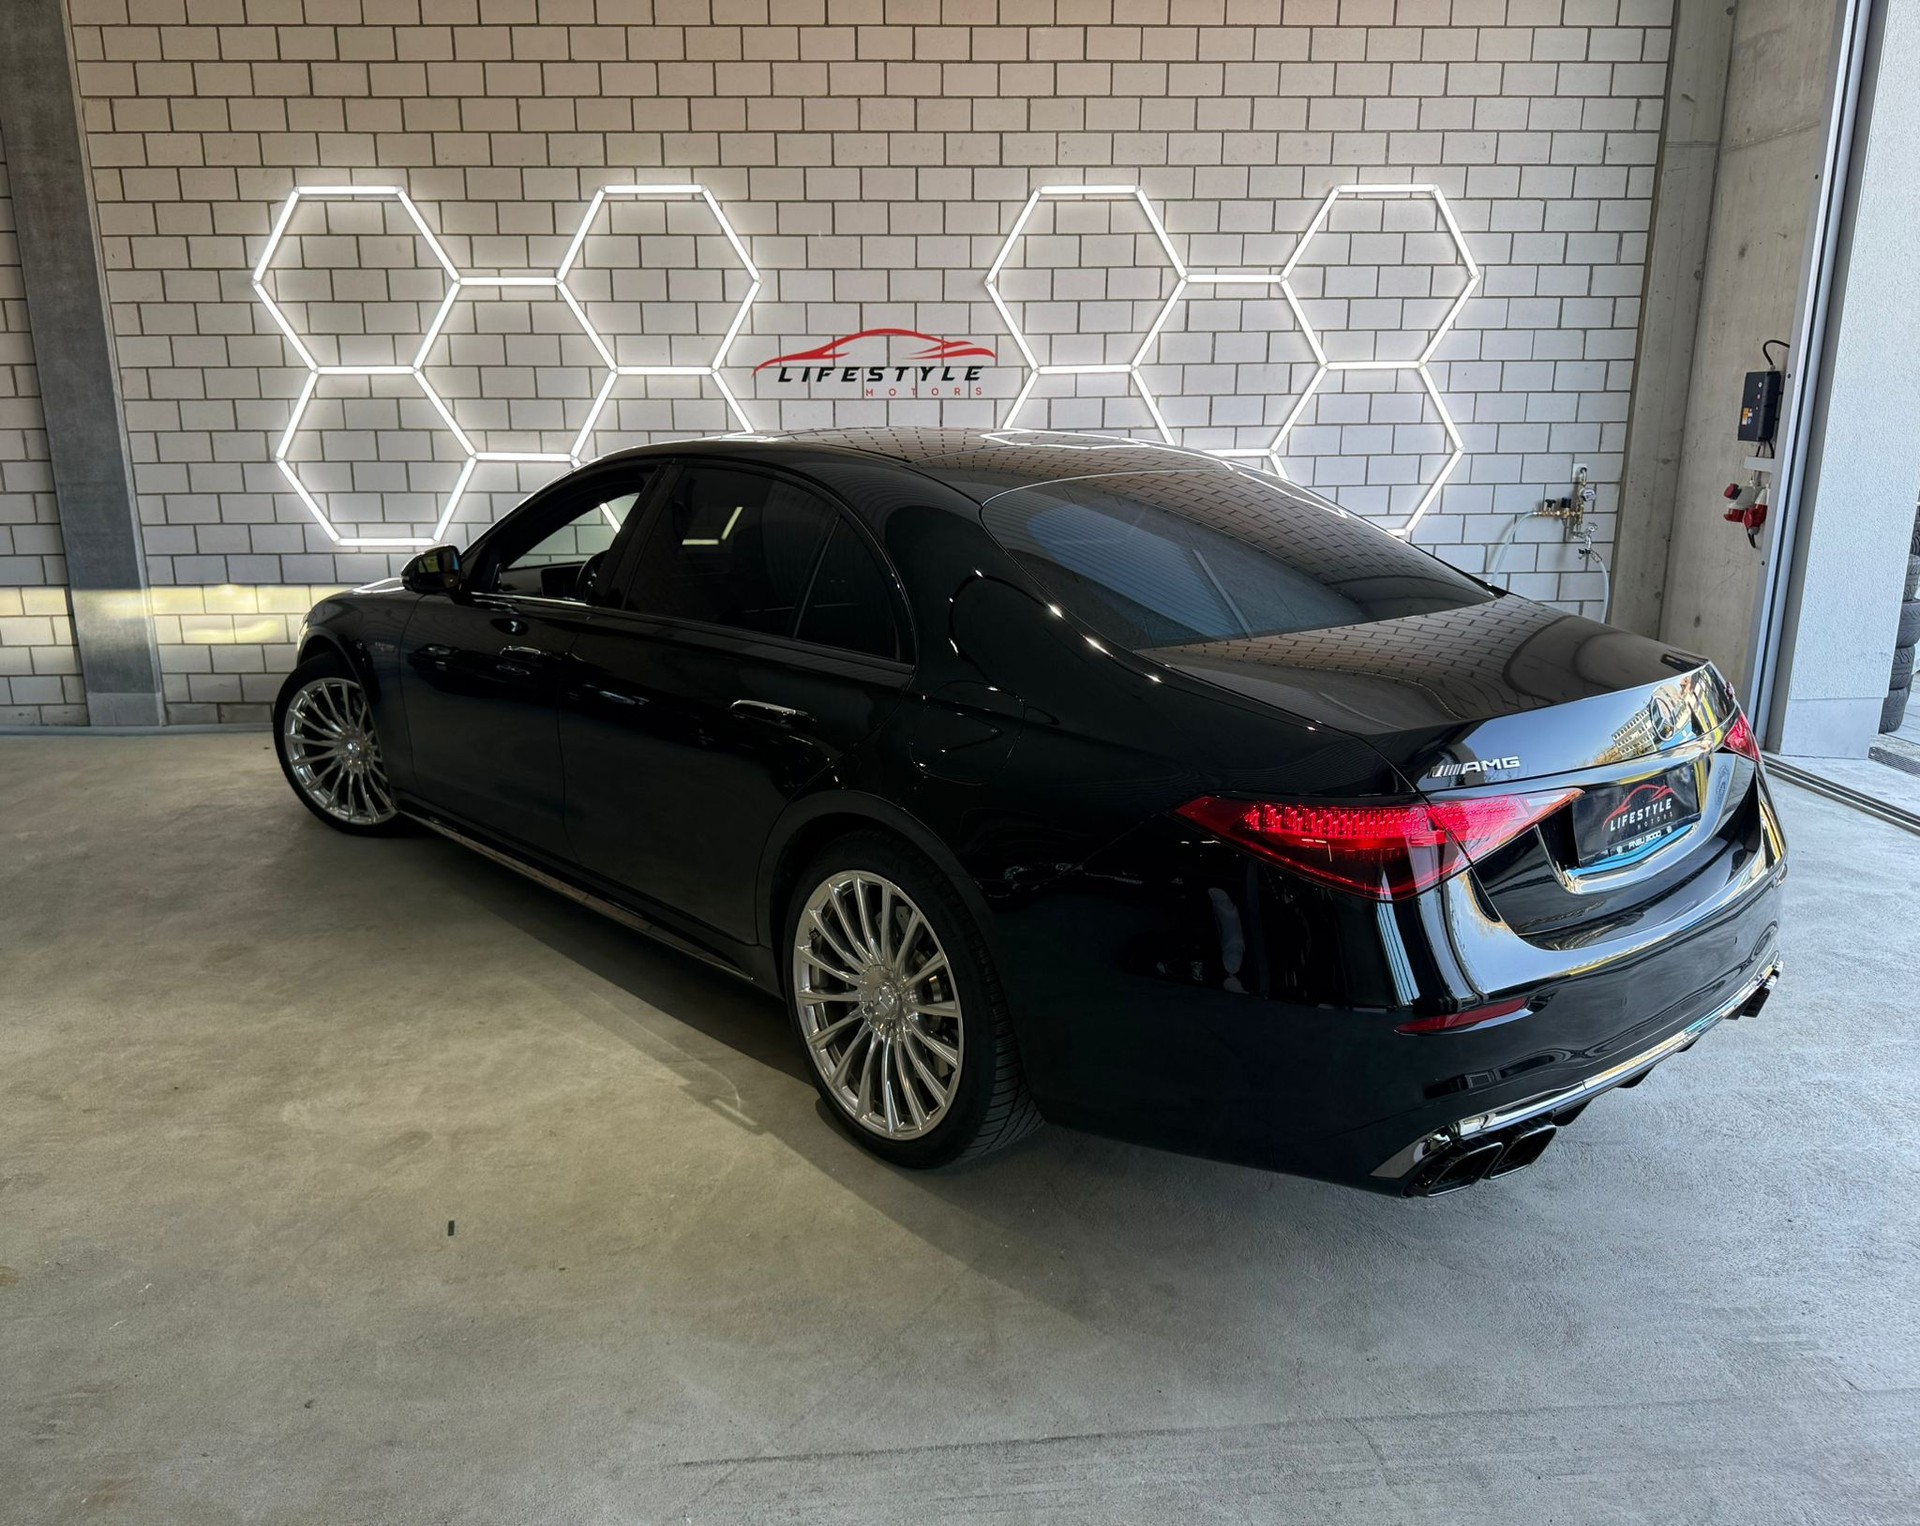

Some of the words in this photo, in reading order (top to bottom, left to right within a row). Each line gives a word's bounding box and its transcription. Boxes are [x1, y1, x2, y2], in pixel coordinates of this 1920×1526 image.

[778, 366, 984, 382] LIFESTYLE
[865, 387, 982, 397] MOTORS
[1460, 756, 1520, 775] AMG
[1610, 798, 1672, 832] LIFESTYLE
[1637, 811, 1673, 830] MOTORS
